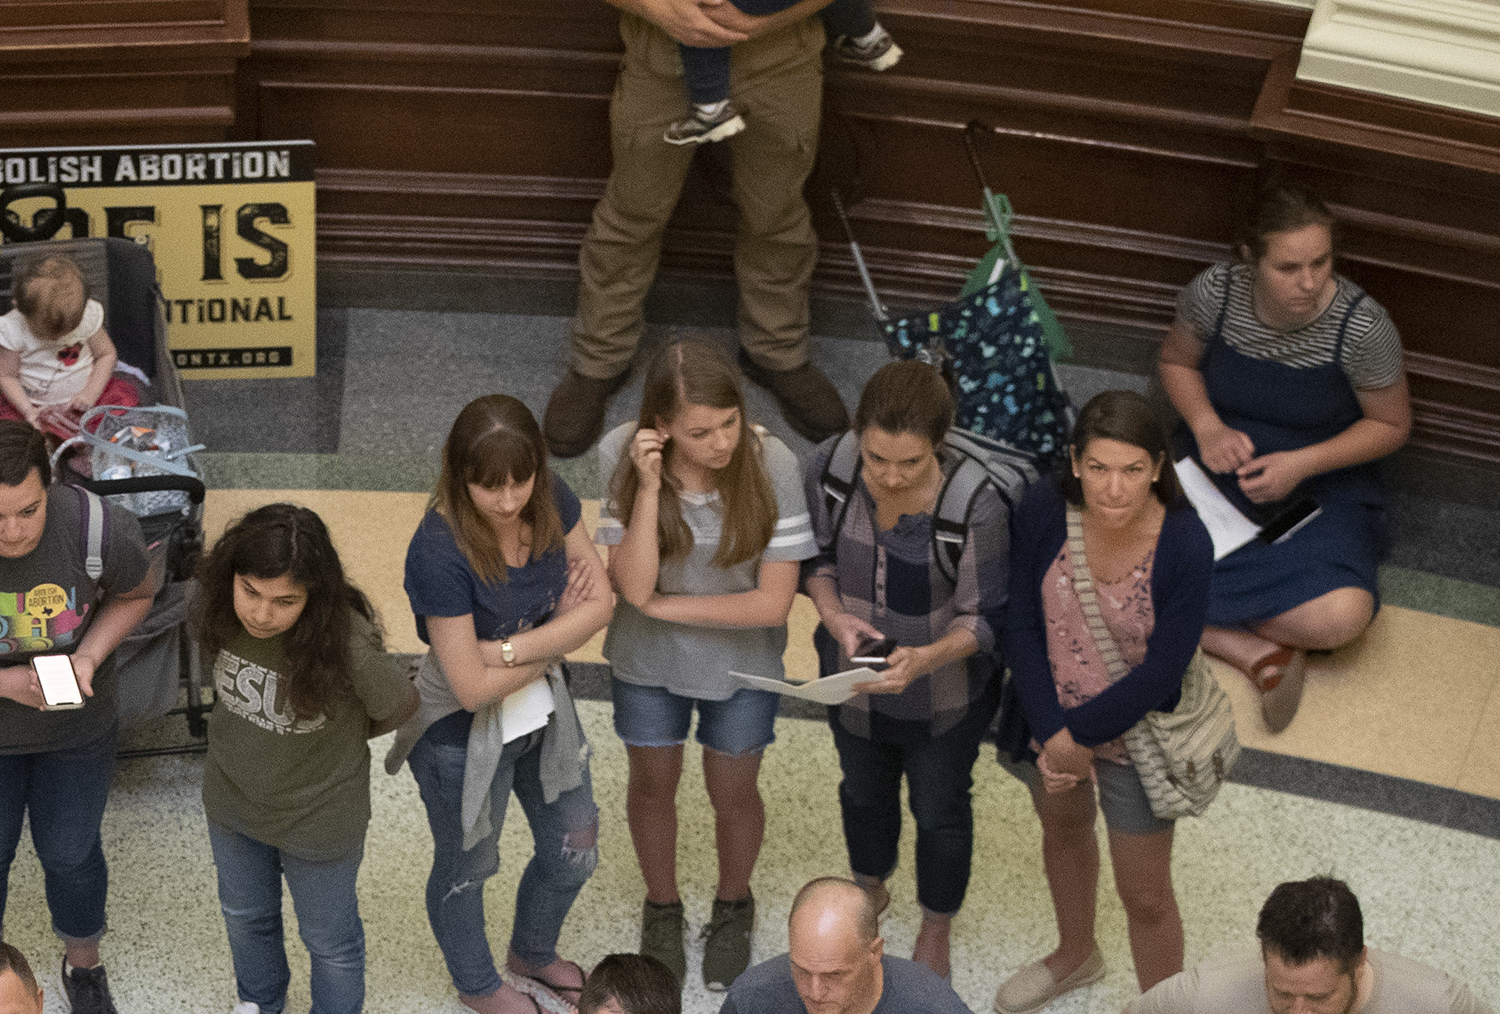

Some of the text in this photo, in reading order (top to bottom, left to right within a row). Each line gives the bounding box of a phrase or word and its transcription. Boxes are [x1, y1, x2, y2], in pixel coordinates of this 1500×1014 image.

[115, 150, 290, 181] ABORTION
[200, 203, 293, 283] IS
[29, 595, 64, 607] ABORTION
